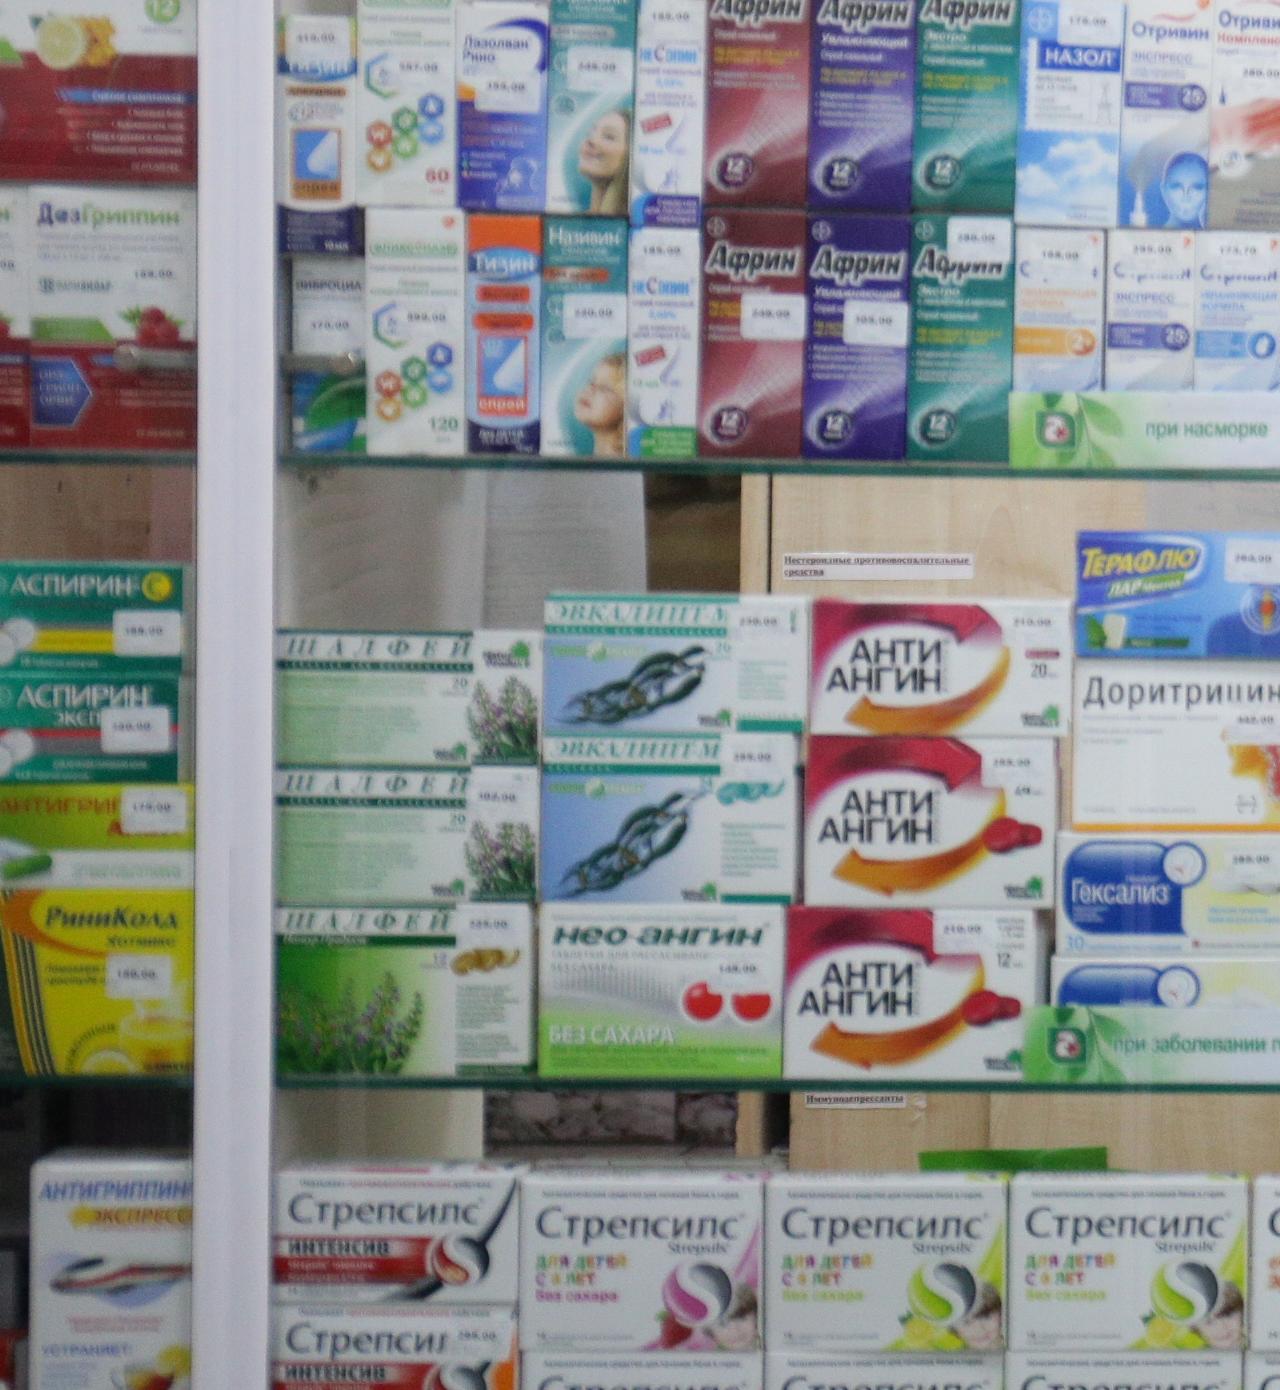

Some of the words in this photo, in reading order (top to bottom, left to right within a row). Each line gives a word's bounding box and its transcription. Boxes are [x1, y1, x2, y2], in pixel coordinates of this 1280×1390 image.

[820, 1, 909, 30] Африн
[924, 0, 1011, 27] Африн
[463, 34, 530, 50] Лазолван
[1132, 21, 1209, 42] Отривин
[1045, 48, 1114, 68] НАЗОЛ
[475, 253, 535, 273] Тизин
[709, 244, 797, 277] Африн
[814, 247, 903, 281] Африн
[428, 417, 459, 433] 120
[1146, 421, 1178, 440] при
[1183, 420, 1269, 441] насморке
[784, 556, 851, 566] Нестероидные
[784, 568, 824, 577] средства
[10, 574, 133, 597] АСПИРИН
[286, 635, 471, 659] ШАЛФЕЙ
[849, 638, 942, 666] АНТИ
[825, 667, 942, 694] АНГИН
[17, 684, 149, 709] АСПИРИН
[841, 789, 934, 815] АНТИ
[818, 818, 933, 844] АНГИН
[1070, 878, 1170, 905] Гексализ
[821, 961, 914, 987] АНТИ
[797, 990, 913, 1016] АНГИН
[590, 1025, 676, 1045] САХАРА
[1113, 1036, 1145, 1056] при
[1156, 1033, 1266, 1054] заболевании
[288, 1192, 480, 1231] Стрепсилс
[535, 1205, 739, 1246] Стрепсилс
[781, 1206, 983, 1246] Стрепсилс
[1025, 1205, 1226, 1246] Стрепсилс
[288, 1241, 390, 1256] ИНТЕНСИВ
